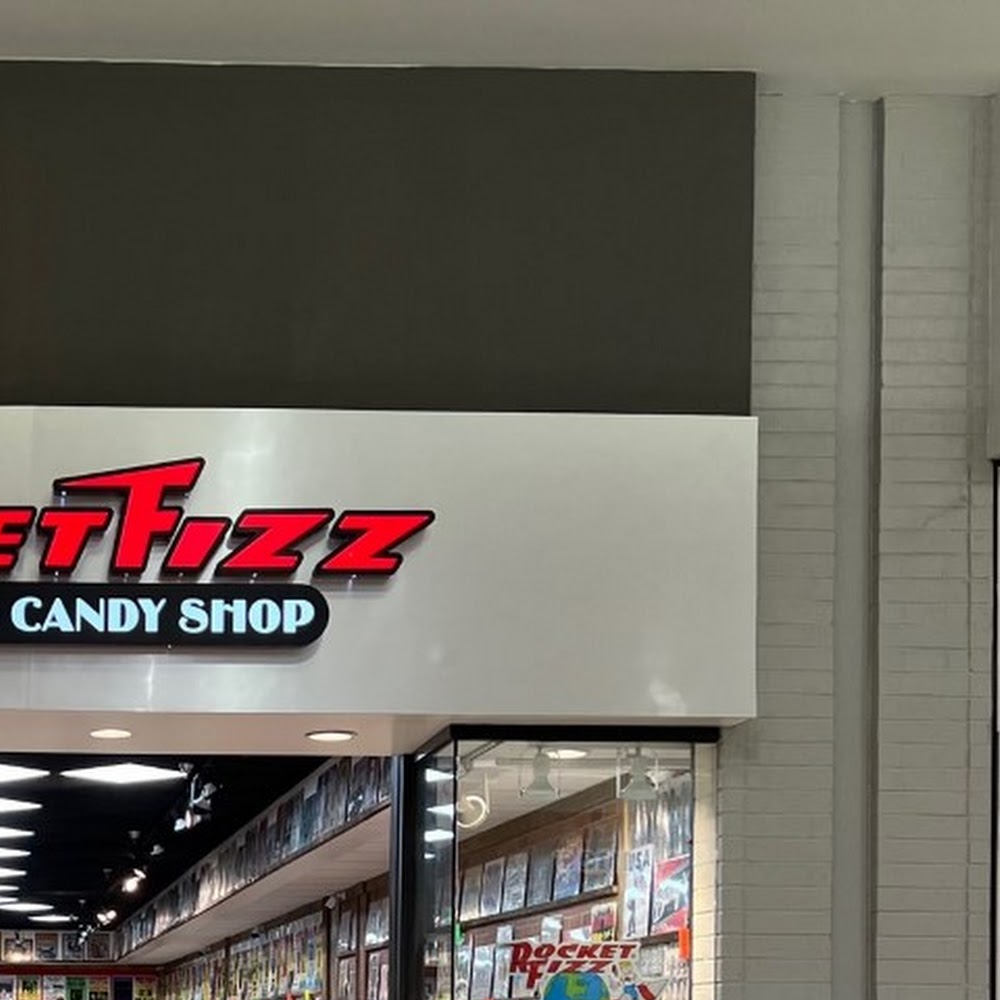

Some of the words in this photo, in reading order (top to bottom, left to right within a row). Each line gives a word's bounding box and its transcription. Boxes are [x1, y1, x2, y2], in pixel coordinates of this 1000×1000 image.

[10, 597, 165, 634] CANDY
[178, 599, 316, 636] SHOP
[509, 941, 637, 973] ROCKET
[524, 960, 613, 989] FIZZ
